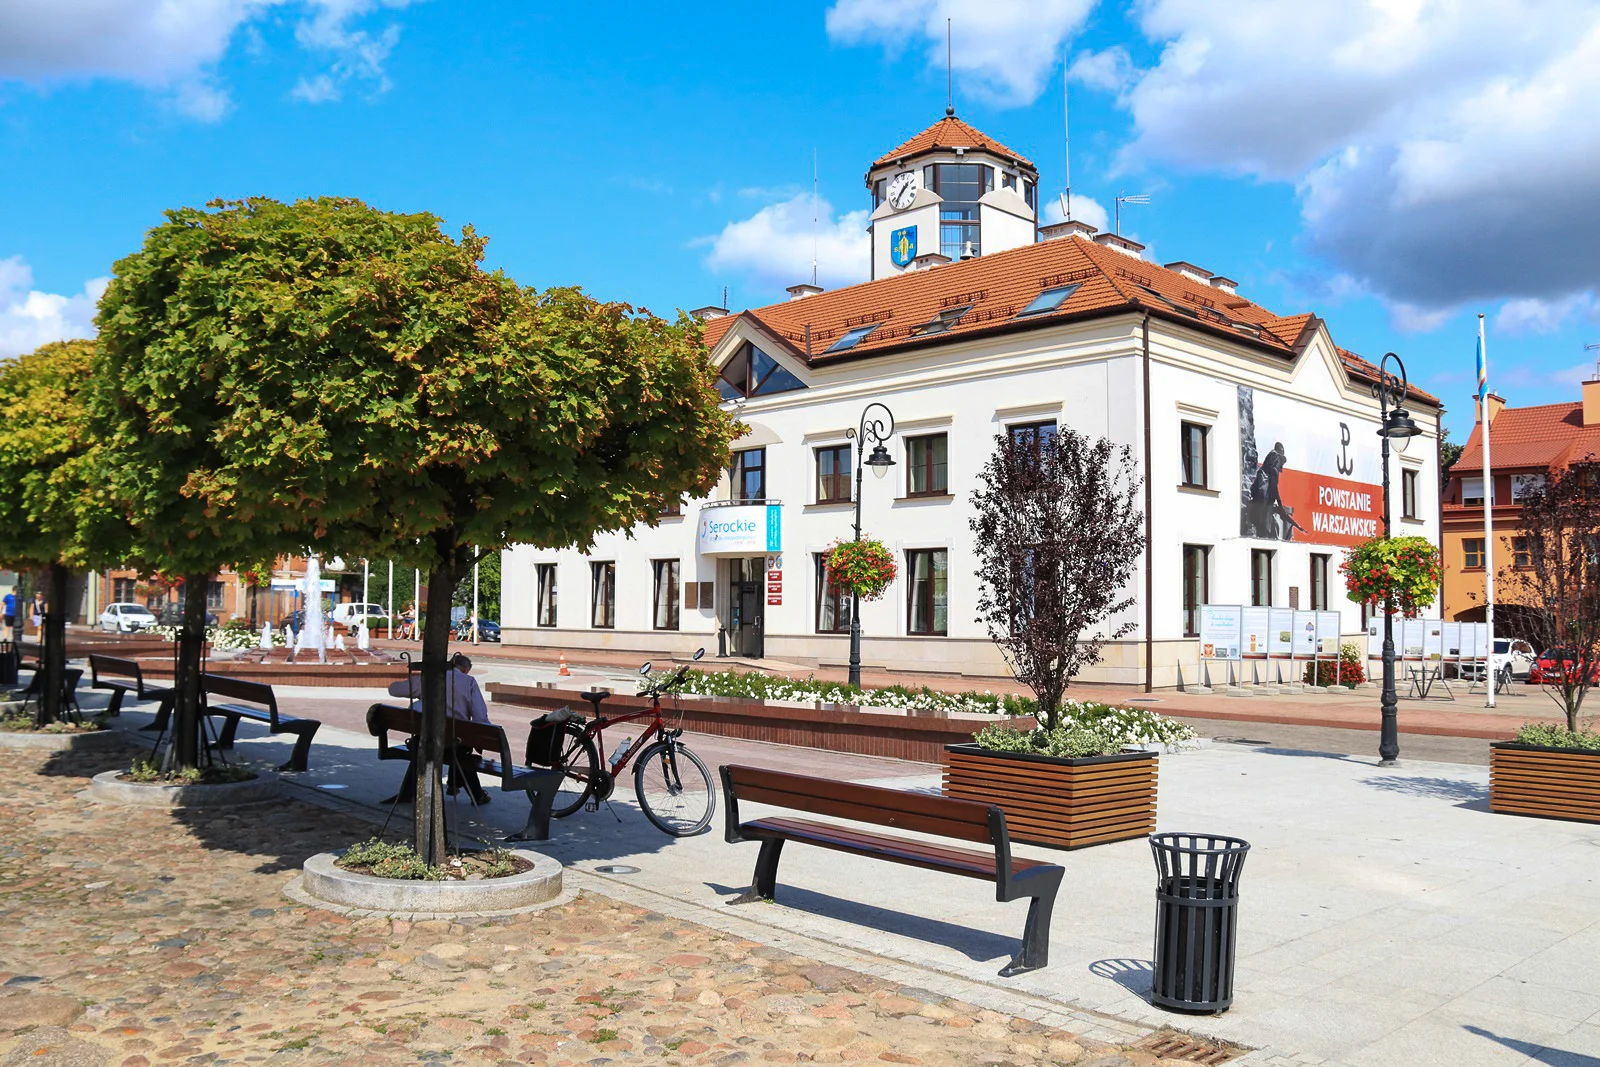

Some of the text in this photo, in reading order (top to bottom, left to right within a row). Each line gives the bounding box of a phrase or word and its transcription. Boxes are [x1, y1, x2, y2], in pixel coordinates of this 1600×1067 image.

[1318, 485, 1371, 512] POWSTANIE
[709, 519, 756, 534] Serockie
[1312, 511, 1377, 538] WARSZAWSKIE
[621, 742, 641, 763] CLIMBER
